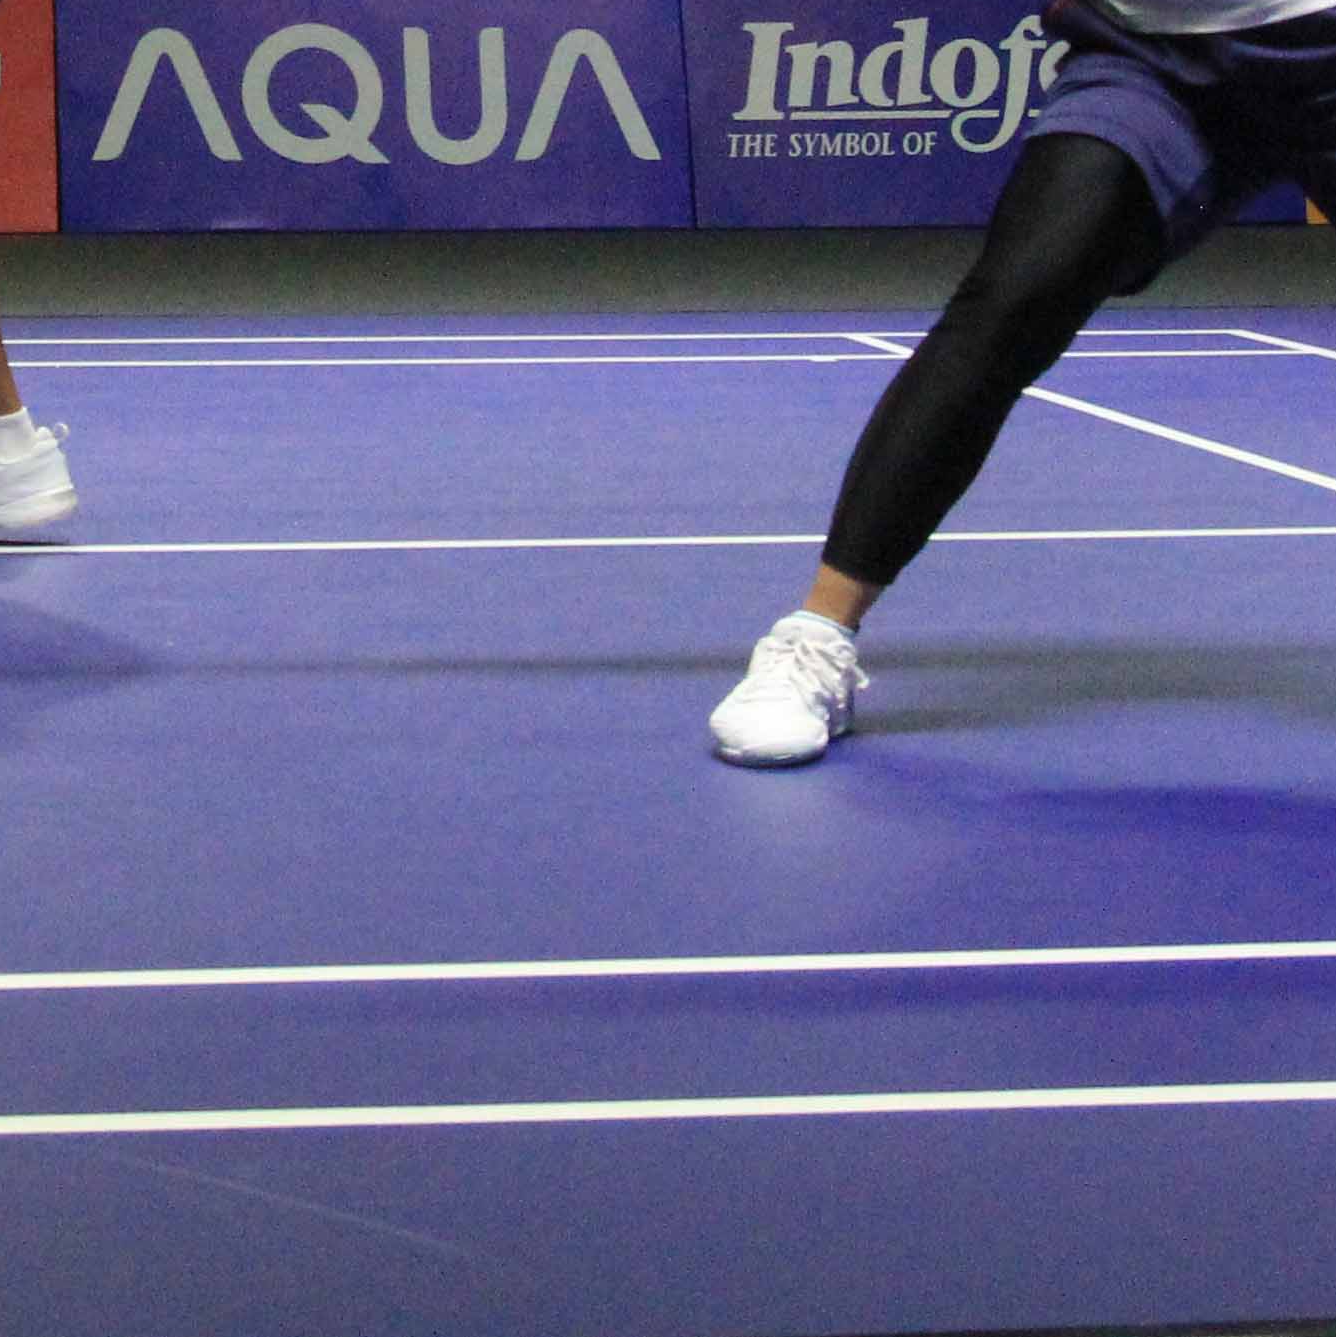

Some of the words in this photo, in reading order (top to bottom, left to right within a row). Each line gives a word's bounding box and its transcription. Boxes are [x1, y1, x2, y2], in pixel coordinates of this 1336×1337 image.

[91, 22, 663, 166] AQUA
[727, 133, 777, 158] THE
[788, 132, 896, 157] SYMBOL
[902, 130, 939, 156] OF
[732, 14, 1071, 154] Indof
